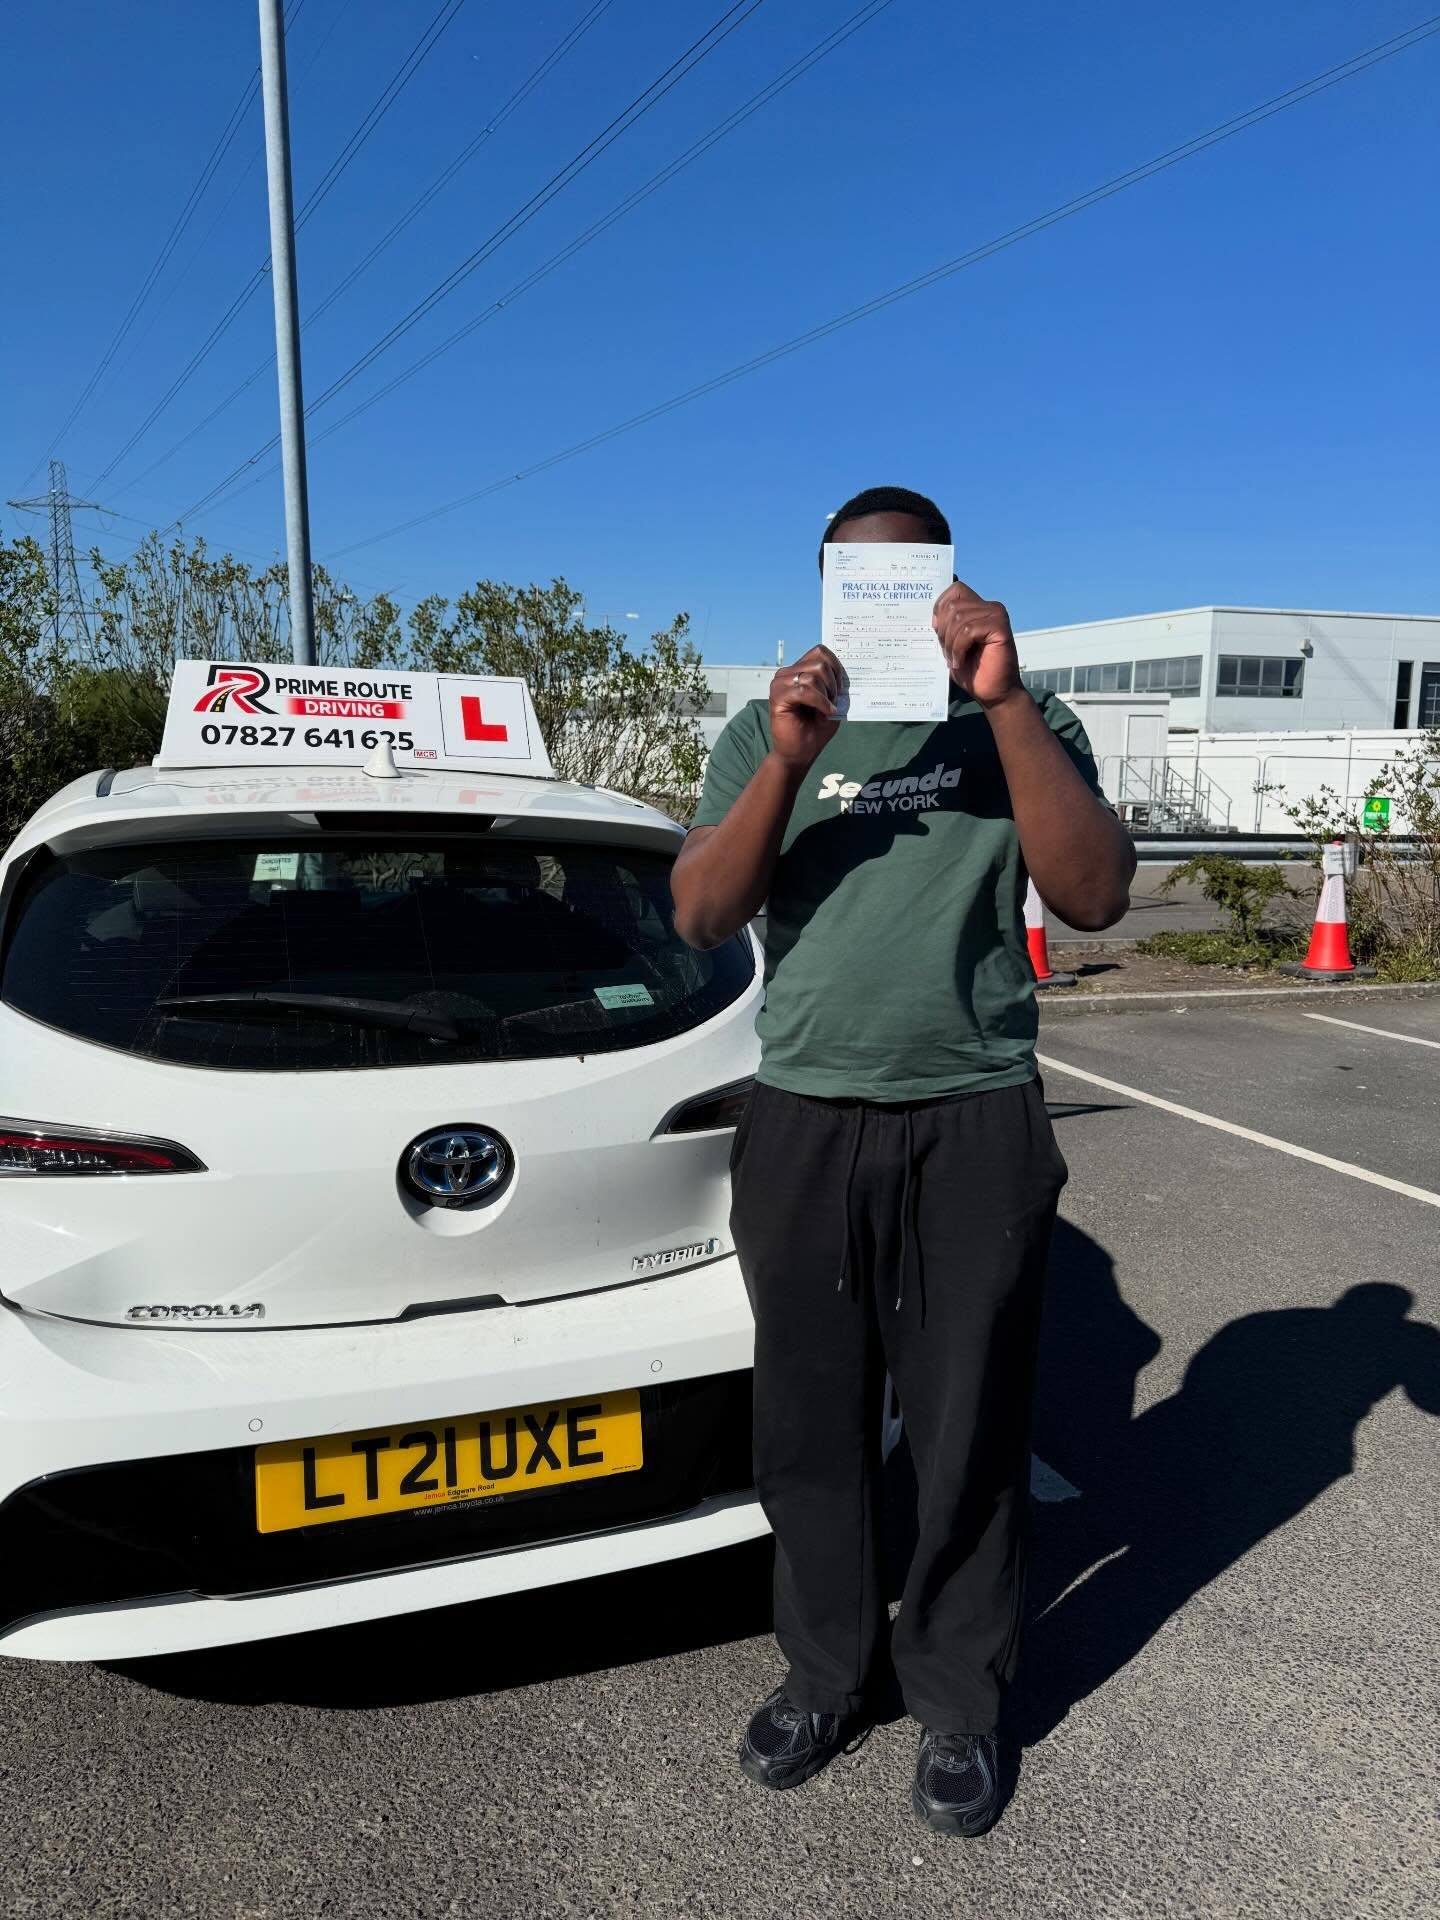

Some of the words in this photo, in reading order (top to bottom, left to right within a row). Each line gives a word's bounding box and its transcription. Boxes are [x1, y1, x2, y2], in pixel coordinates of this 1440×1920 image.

[842, 583, 891, 591] PRACTICAL
[893, 583, 933, 591] DRIVING
[842, 592, 860, 600] TEST
[863, 592, 882, 600] PASS
[883, 591, 933, 600] CERTIFICATE
[275, 677, 338, 696] PRIME
[344, 680, 412, 700] ROUTE
[305, 701, 385, 717] DRIVING
[460, 696, 508, 742] L
[201, 724, 296, 747] 07827
[304, 728, 354, 749] 641
[818, 763, 962, 799] Secunda
[840, 799, 883, 815] NEW
[887, 793, 940, 812] YORK
[631, 1243, 706, 1271] HYBRID
[125, 1303, 266, 1321] COROLLA
[302, 1430, 457, 1510] LT21
[479, 1405, 604, 1480] UXE
[447, 1487, 476, 1497] Edgware
